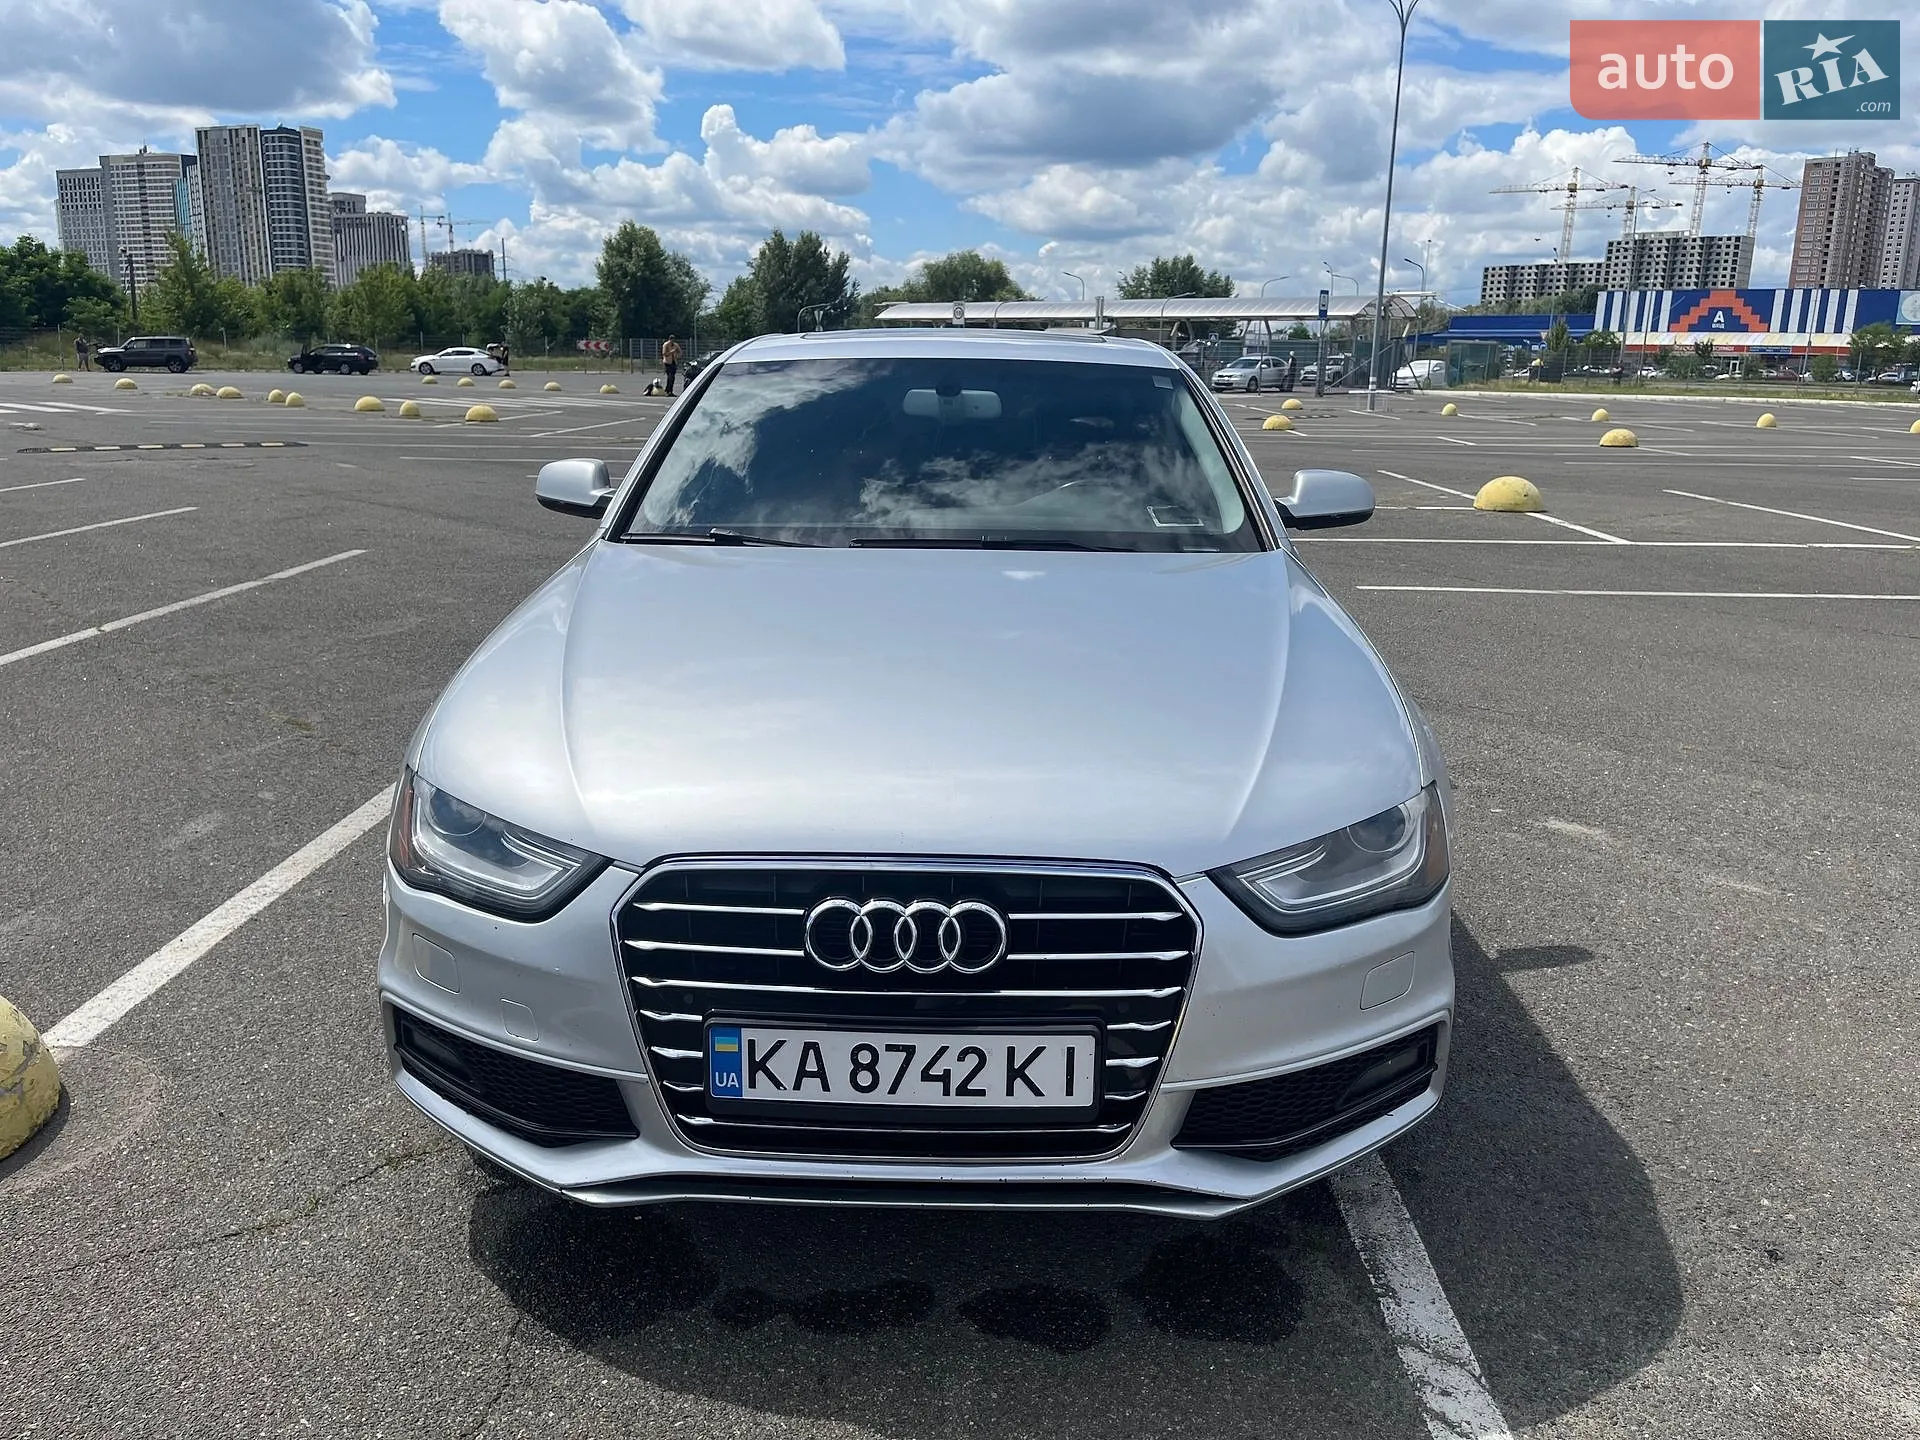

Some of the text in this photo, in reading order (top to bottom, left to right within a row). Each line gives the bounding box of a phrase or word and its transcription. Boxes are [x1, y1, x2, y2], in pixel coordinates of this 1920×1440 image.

[715, 1072, 739, 1089] UA
[747, 1038, 831, 1093] KA
[849, 1042, 987, 1097] 8742
